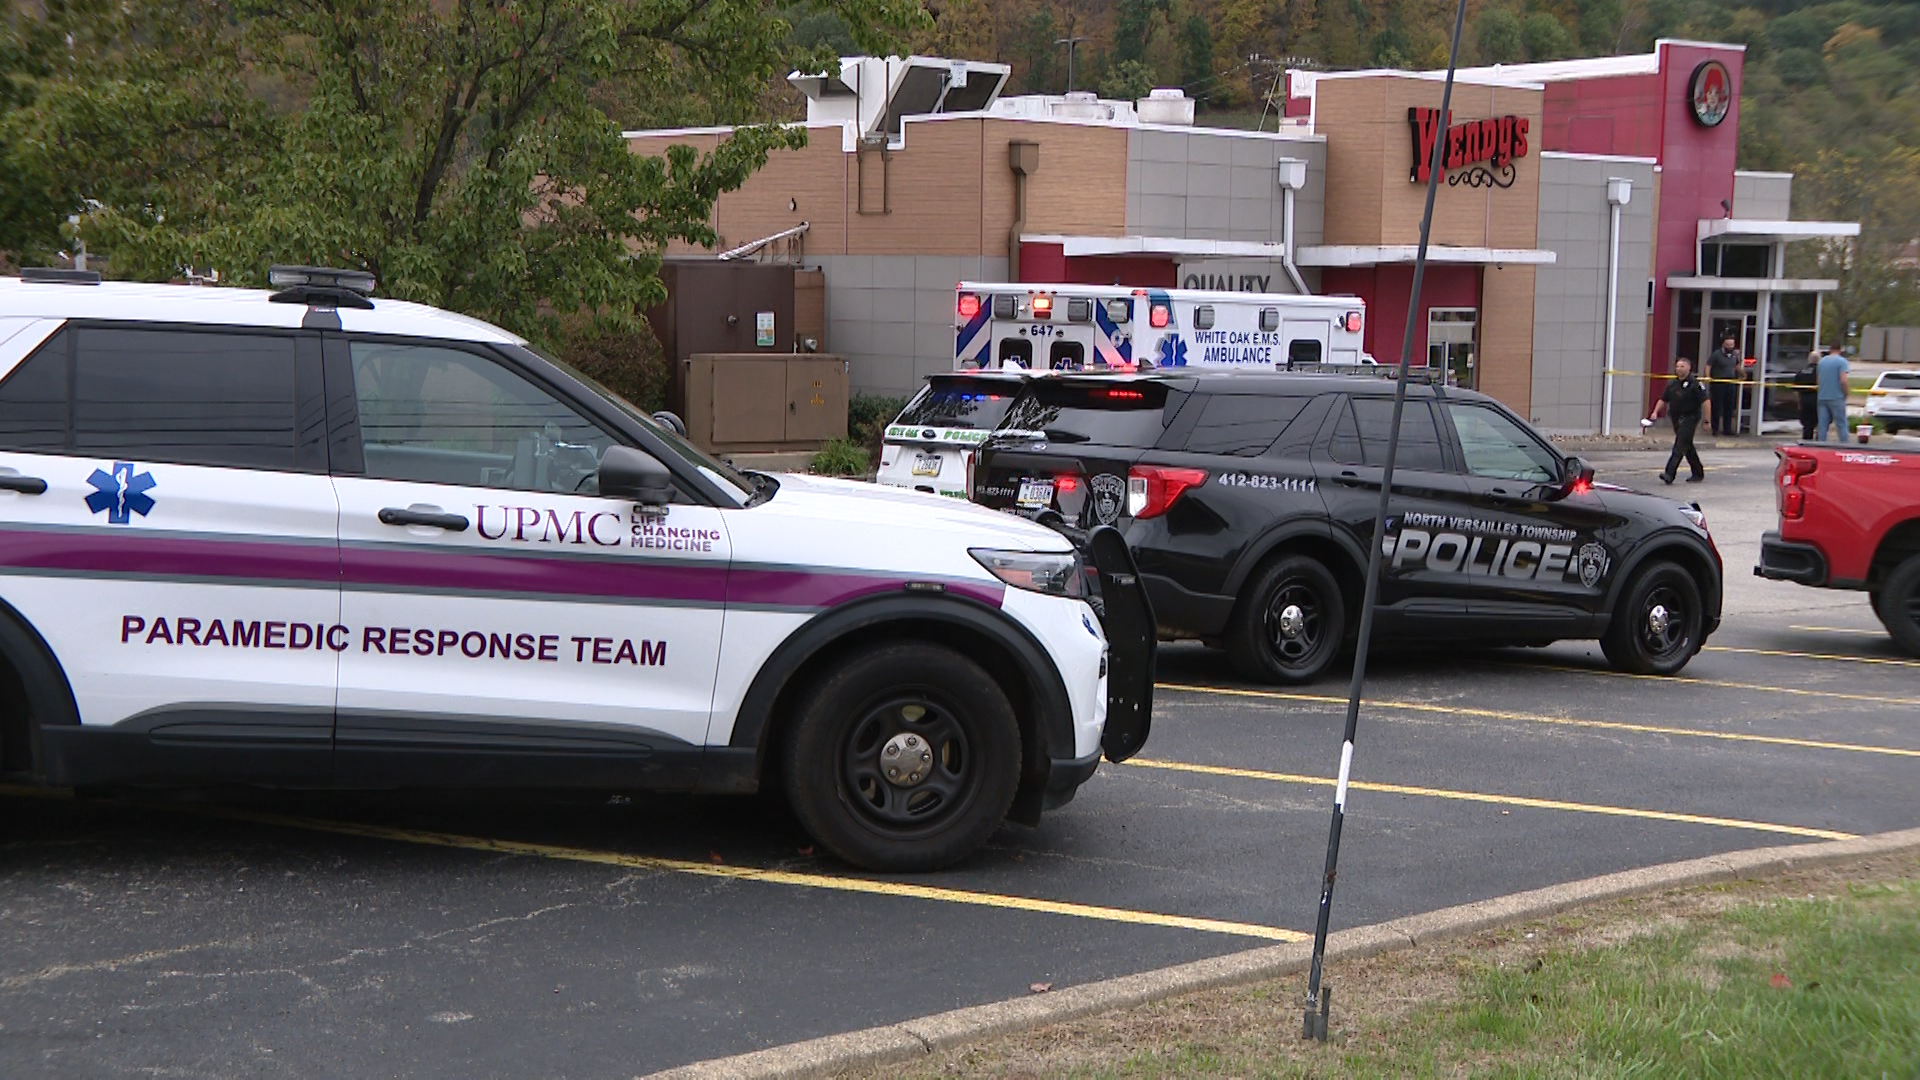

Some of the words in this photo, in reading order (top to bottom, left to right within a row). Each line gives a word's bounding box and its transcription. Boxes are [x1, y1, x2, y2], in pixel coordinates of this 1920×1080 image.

[1031, 325, 1053, 336] 647
[1195, 331, 1227, 344] WHITE
[1229, 332, 1250, 345] OAK
[1252, 333, 1281, 346] E.M.S.
[1203, 347, 1271, 363] AMBULANCE
[1218, 473, 1315, 493] 412-823-1111
[473, 504, 621, 546] UPMC
[631, 514, 666, 526] LIFE
[1403, 511, 1447, 528] NORTH
[1449, 517, 1518, 536] VERSAILLES
[1520, 525, 1577, 541] TOWNSHIP
[631, 525, 721, 540] CHANGING
[631, 537, 712, 552] MEDICINE
[1391, 529, 1573, 582] POLICE
[121, 615, 349, 652] PARAMEDIC
[362, 626, 559, 662] RESPONSE
[571, 637, 667, 666] TEAM
